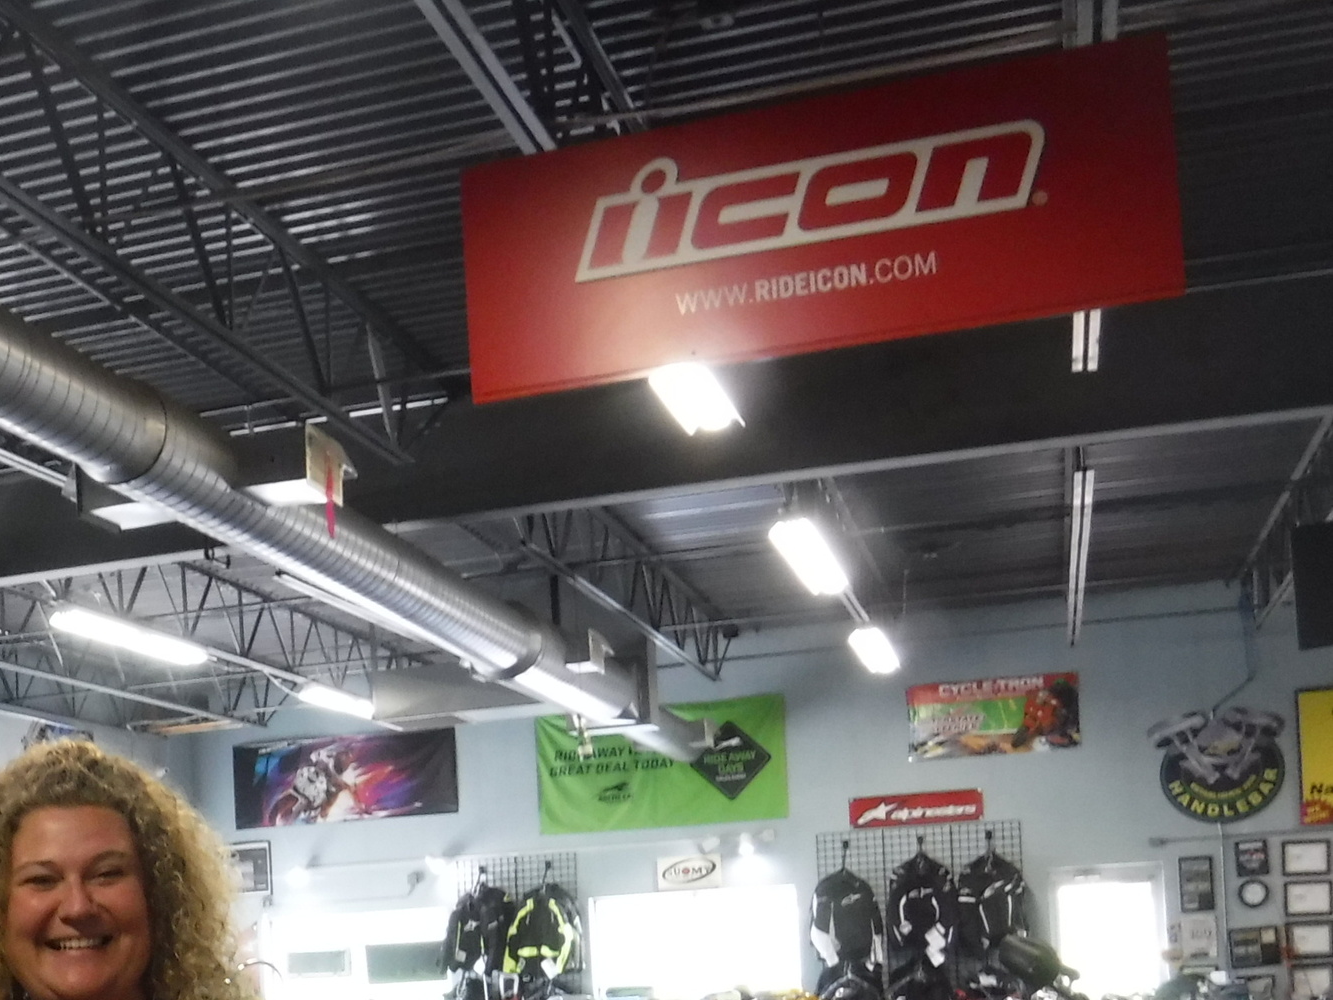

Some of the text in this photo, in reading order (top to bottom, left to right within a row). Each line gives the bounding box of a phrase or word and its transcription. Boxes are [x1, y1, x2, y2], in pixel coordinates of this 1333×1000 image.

[675, 250, 938, 316] WWW.RIDEICON.COM
[549, 758, 675, 777] GREAT DEAL TODAY
